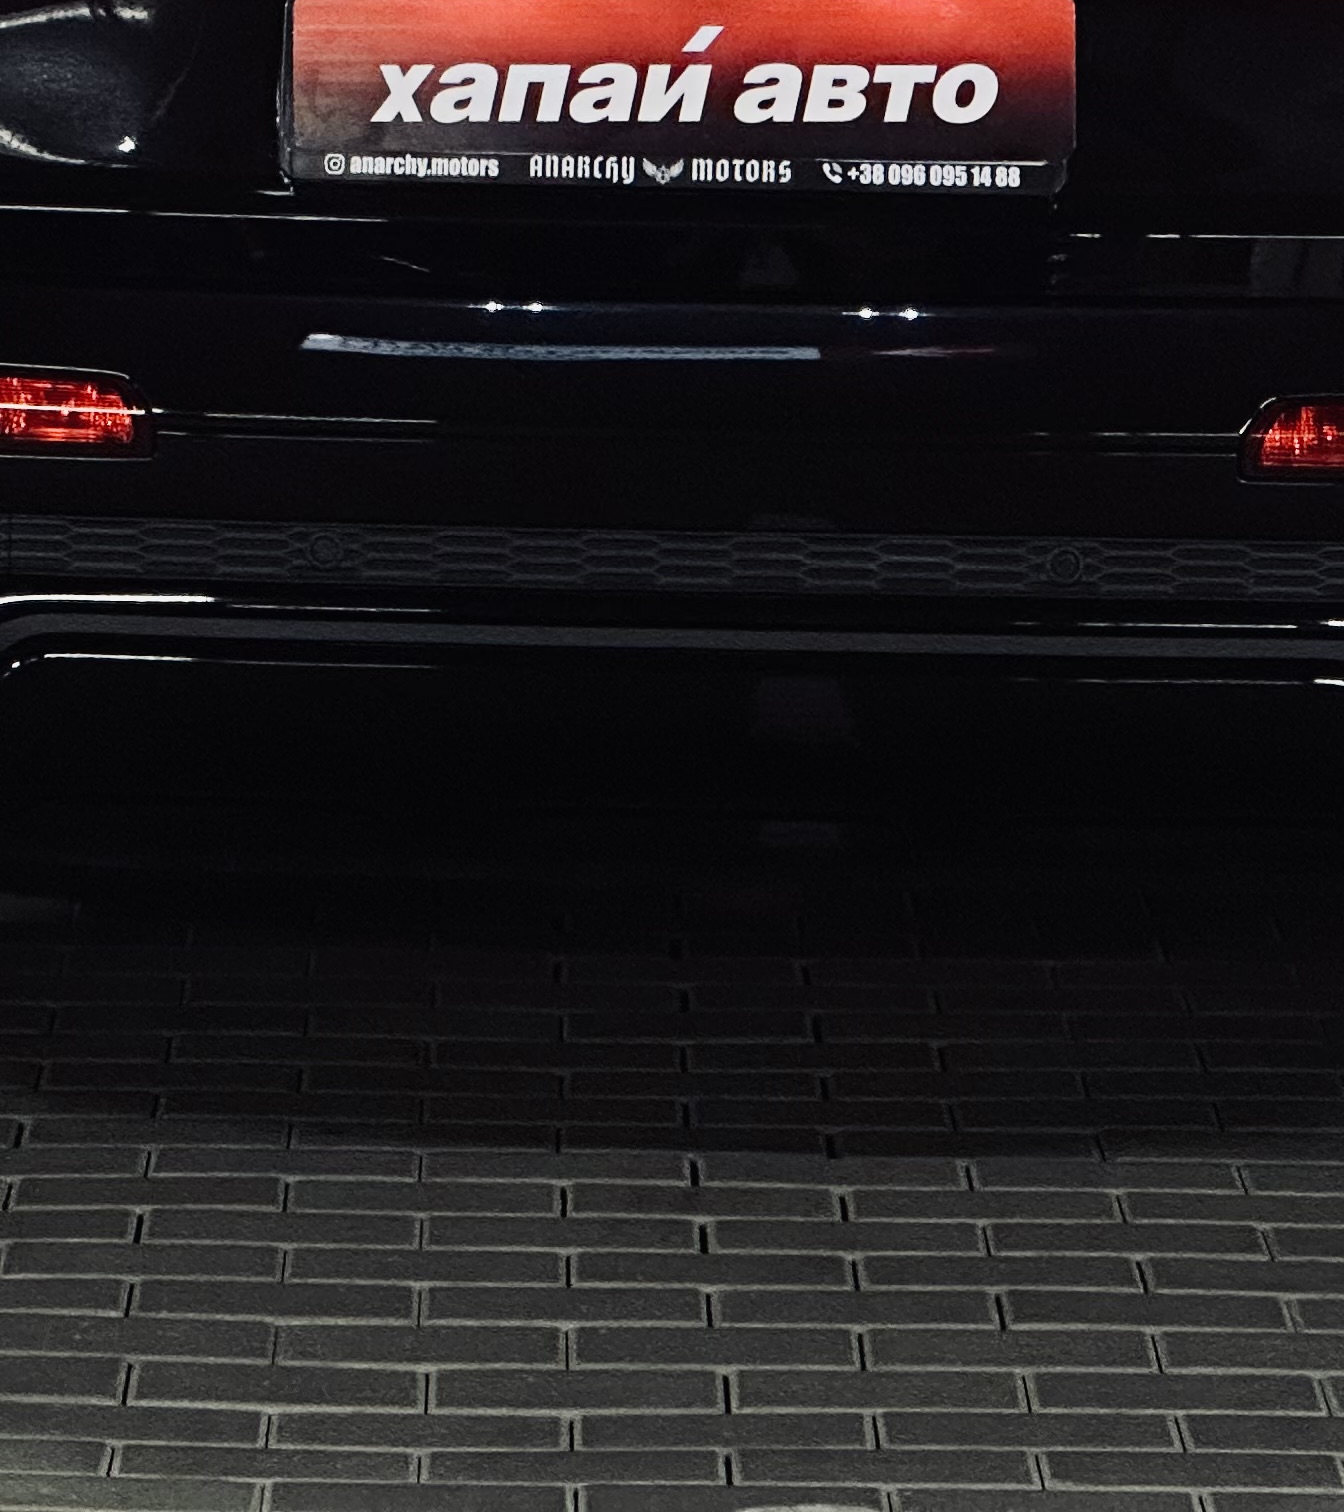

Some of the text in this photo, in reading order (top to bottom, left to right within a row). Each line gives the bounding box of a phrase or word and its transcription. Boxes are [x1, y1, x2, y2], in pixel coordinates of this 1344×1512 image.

[370, 25, 1000, 124] хапай авто
[350, 154, 500, 177] anarchy.motors
[691, 158, 792, 183] MOTORS
[847, 163, 1021, 188] +38 096 095 14 88
